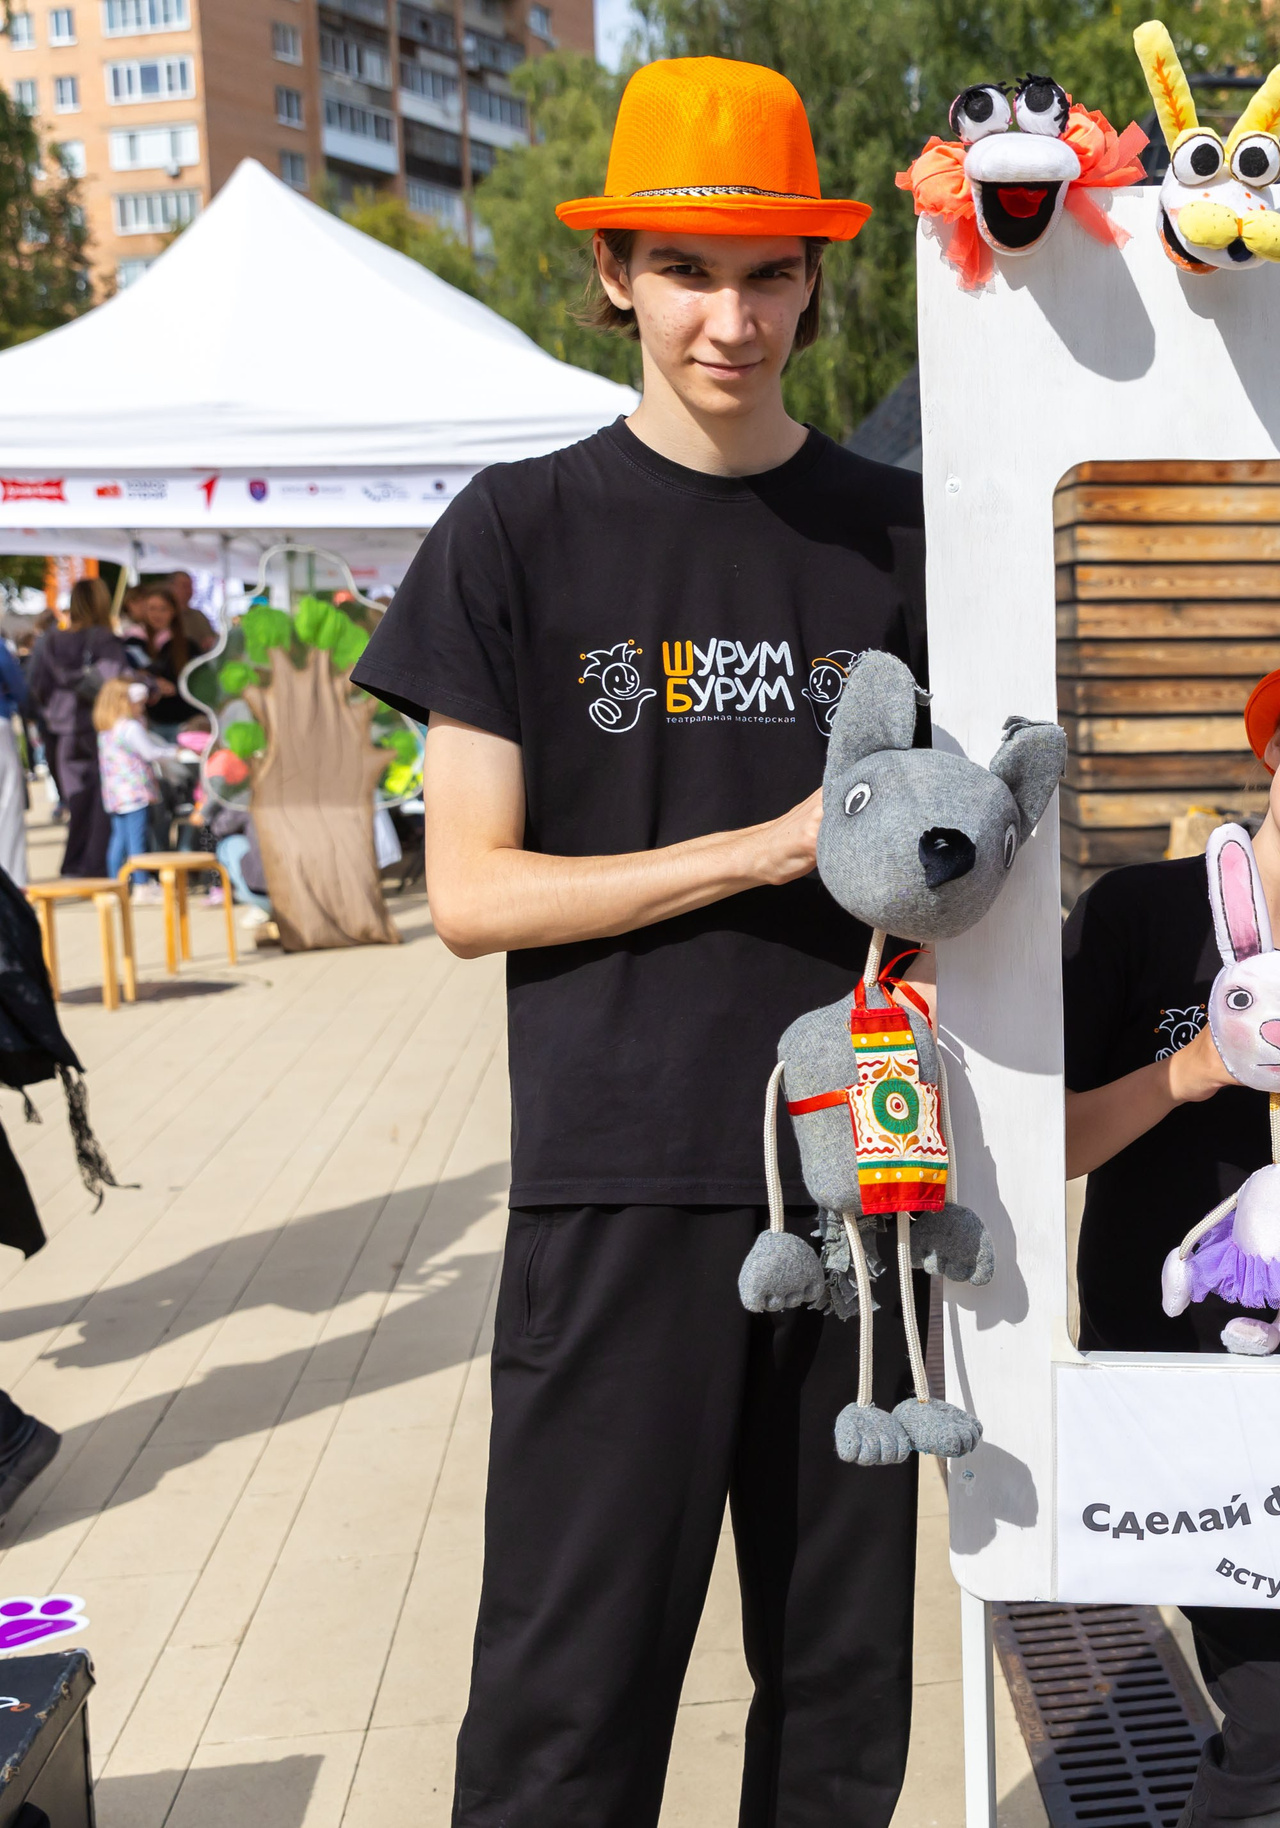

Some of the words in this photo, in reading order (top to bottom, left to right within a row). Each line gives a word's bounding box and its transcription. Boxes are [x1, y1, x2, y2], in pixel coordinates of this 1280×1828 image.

[662, 638, 794, 676] ШУРУМ
[666, 674, 795, 713] БУРУМ
[666, 714, 732, 724] театральная
[735, 715, 796, 724] мастерская
[1082, 1494, 1252, 1540] Сделай
